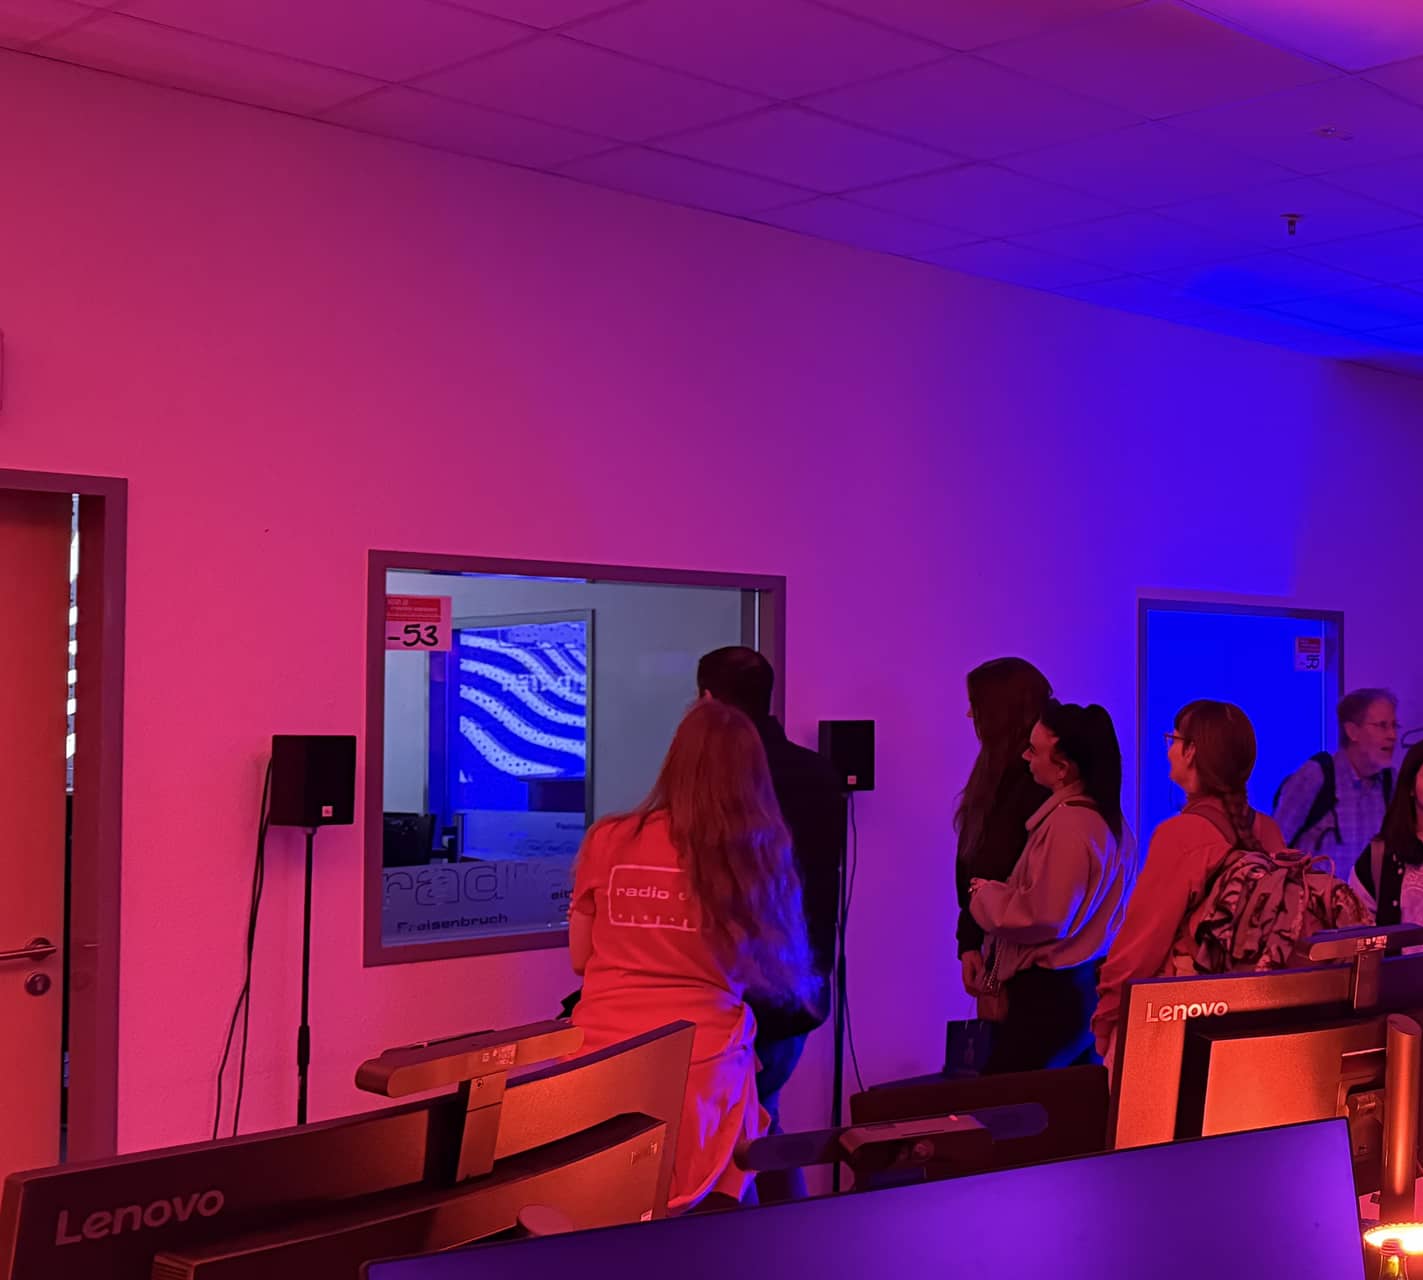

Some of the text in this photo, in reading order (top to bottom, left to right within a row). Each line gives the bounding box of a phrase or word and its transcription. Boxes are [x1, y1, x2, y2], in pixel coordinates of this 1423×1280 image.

[615, 885, 671, 901] radio
[1145, 999, 1229, 1023] Lenovo
[55, 1189, 224, 1246] Lenovo
